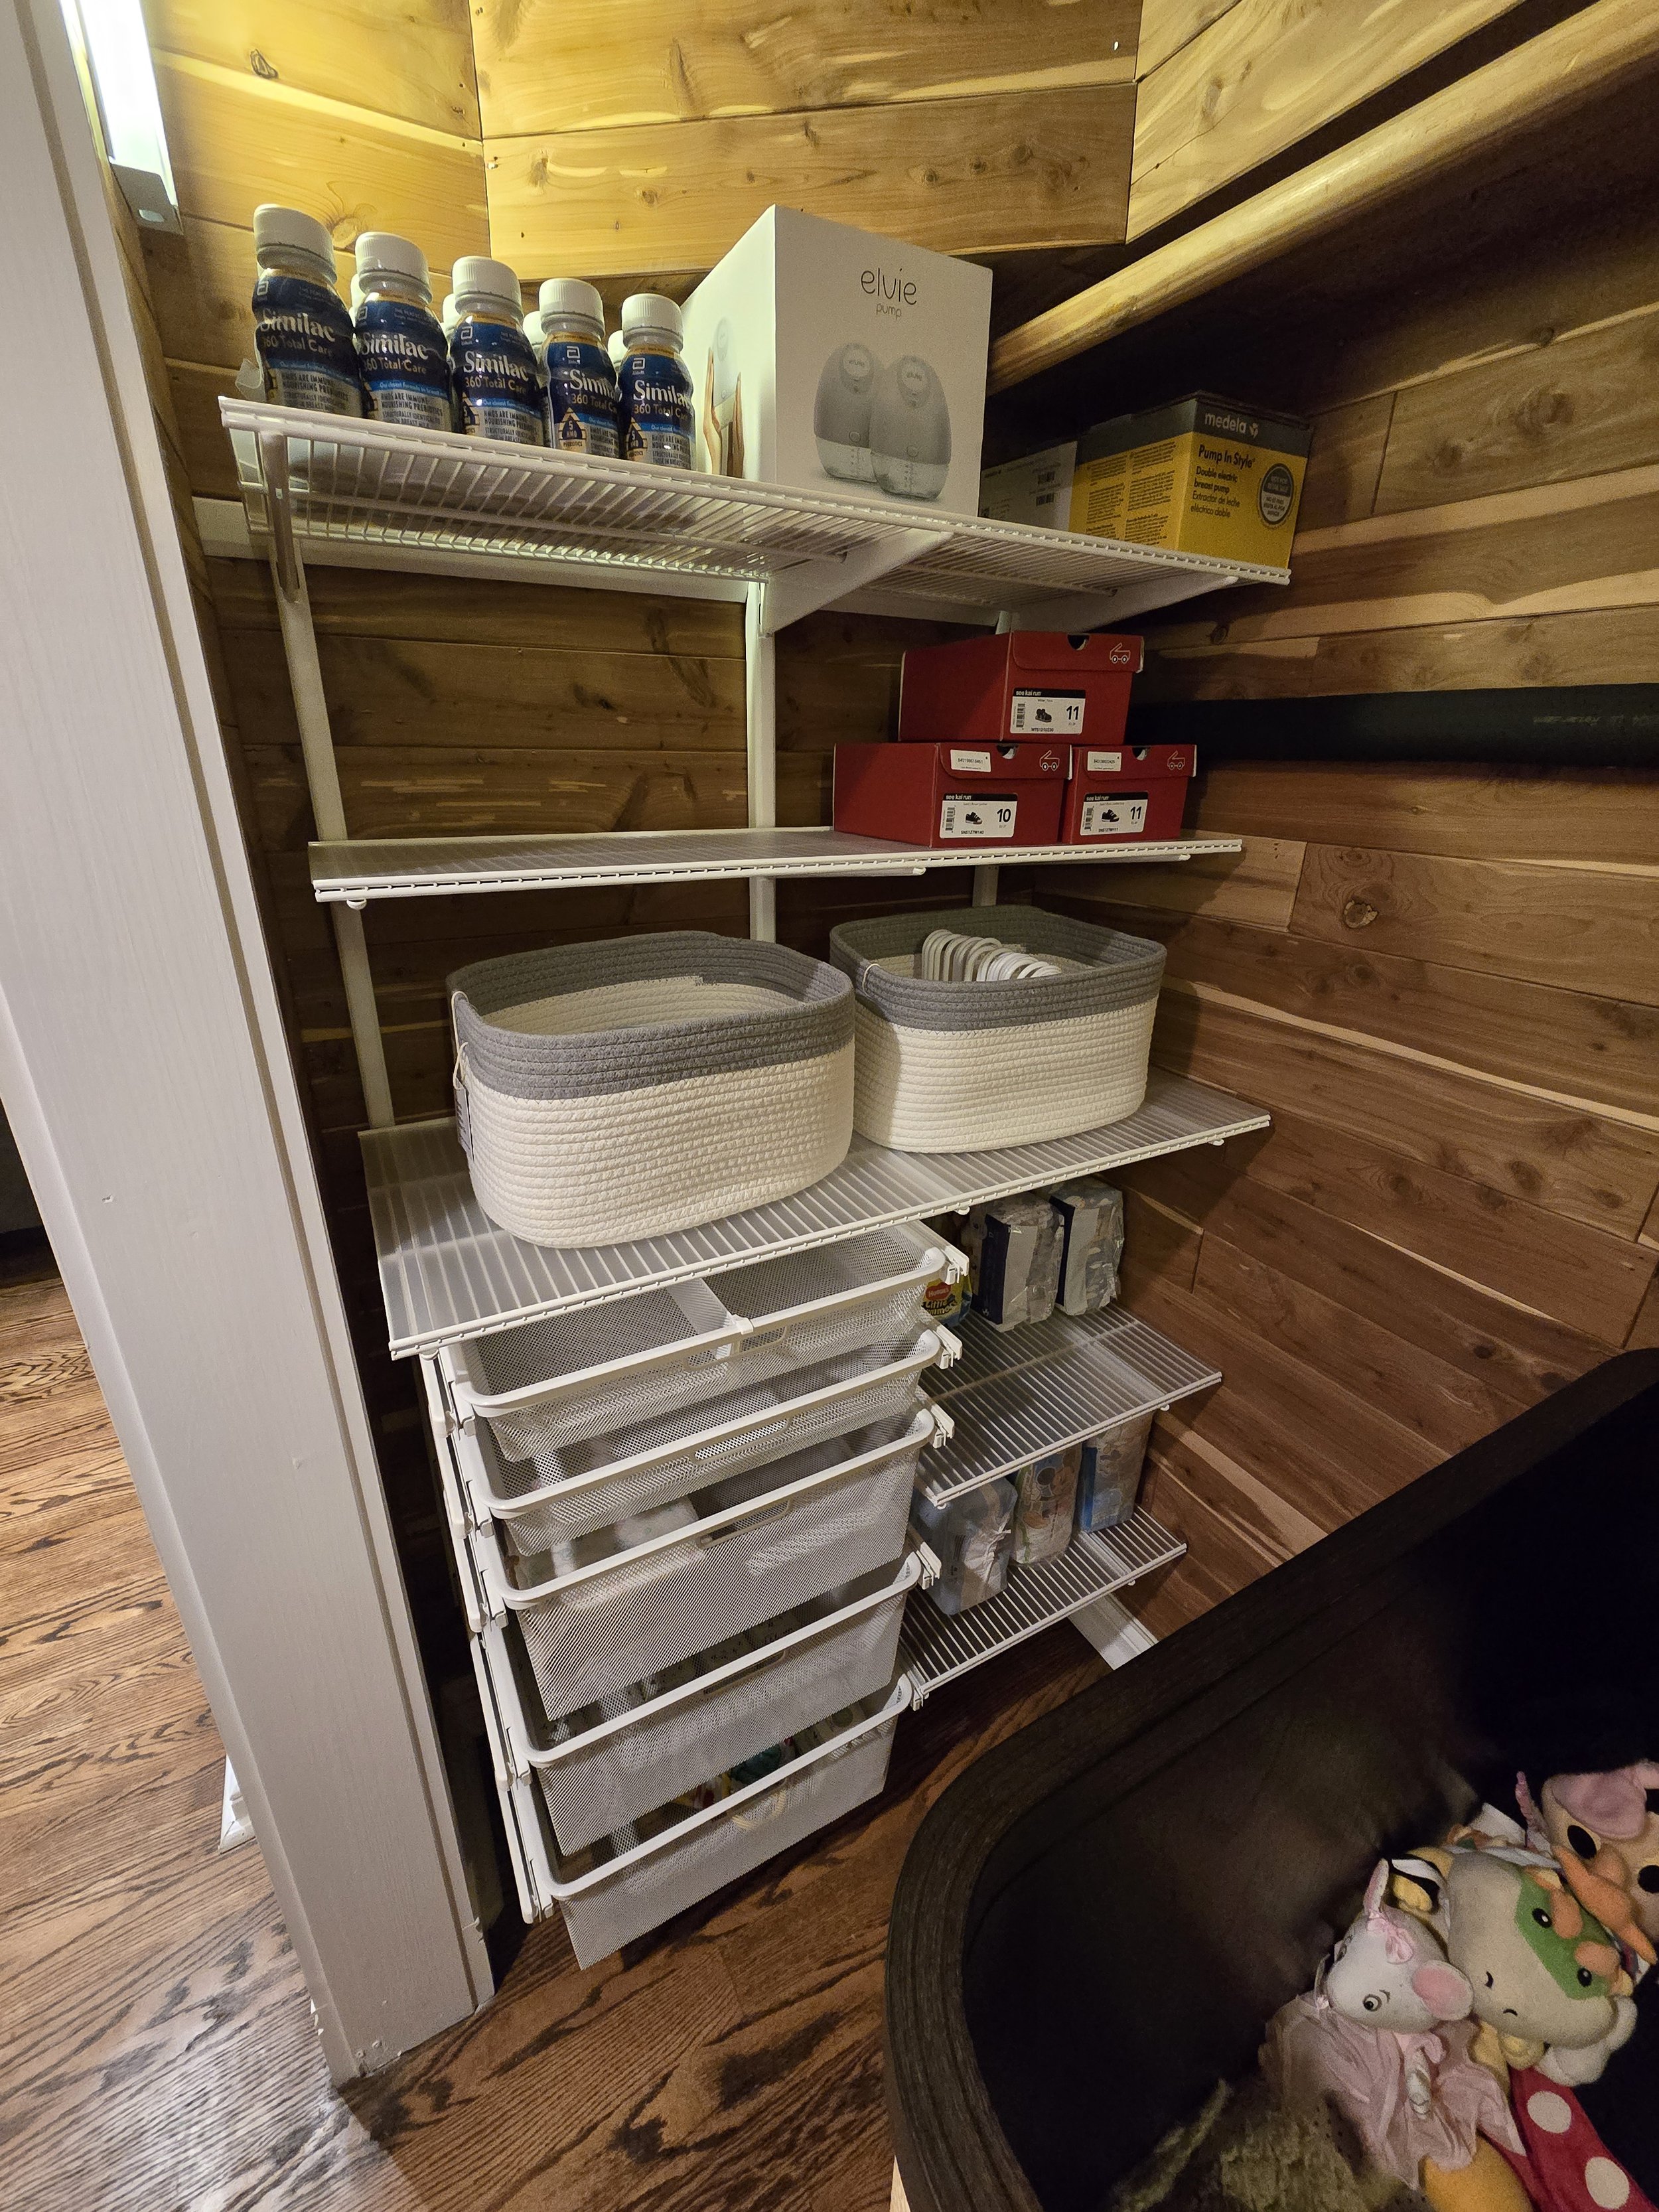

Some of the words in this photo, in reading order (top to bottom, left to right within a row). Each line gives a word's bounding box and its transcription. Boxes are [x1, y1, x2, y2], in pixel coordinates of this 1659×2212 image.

[861, 267, 917, 305] elvie
[876, 303, 902, 319] pump
[260, 308, 335, 342] Similac
[281, 334, 306, 350] Total
[362, 332, 429, 360] Similac
[380, 356, 401, 370] Total
[403, 359, 427, 374] Care
[463, 350, 530, 382] Similac
[465, 376, 482, 388] 360
[482, 376, 506, 390] Total
[381, 400, 413, 411] NOURISHING
[405, 393, 429, 405] IMMUNE
[571, 394, 588, 405] 360
[591, 394, 607, 410] Total
[498, 409, 508, 418] ARE
[634, 403, 651, 414] 360
[653, 403, 673, 416] Total
[484, 417, 516, 428] NOURISHING
[1204, 412, 1247, 434] medela
[666, 435, 674, 444] ARE
[1198, 444, 1222, 465] Pump
[1224, 455, 1232, 464] In
[1196, 466, 1217, 479] Double
[1218, 469, 1238, 482] electric
[1194, 478, 1213, 489] breast
[1213, 483, 1230, 496] pump
[1192, 490, 1218, 503] Extractor
[1218, 496, 1226, 505] de
[1226, 498, 1241, 508] leche
[1214, 508, 1231, 518] doble
[1066, 705, 1080, 720] 11
[997, 808, 1011, 823] 10
[1130, 806, 1142, 820] 11
